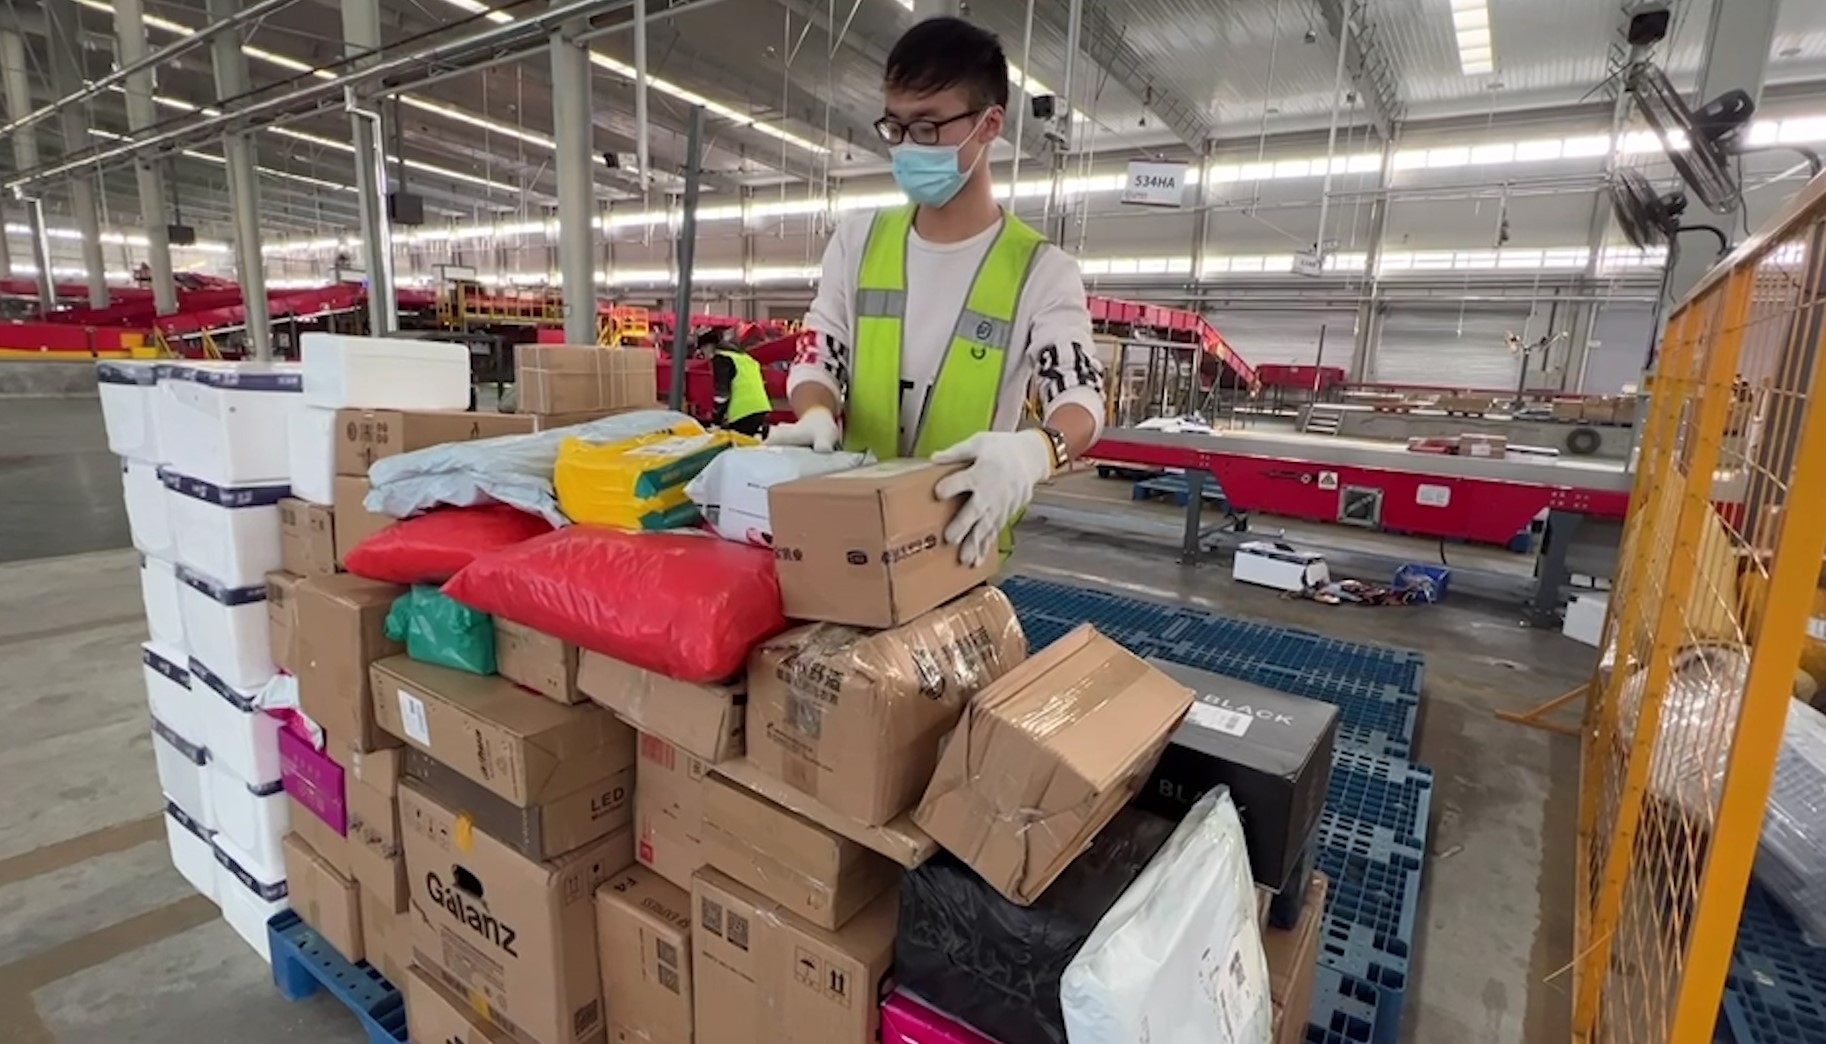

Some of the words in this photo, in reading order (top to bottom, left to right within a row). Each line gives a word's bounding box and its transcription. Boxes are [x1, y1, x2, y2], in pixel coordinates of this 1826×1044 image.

[1133, 174, 1176, 190] 534HA
[1203, 693, 1294, 727] BLACK
[591, 786, 625, 812] LED
[426, 871, 519, 959] Galanz
